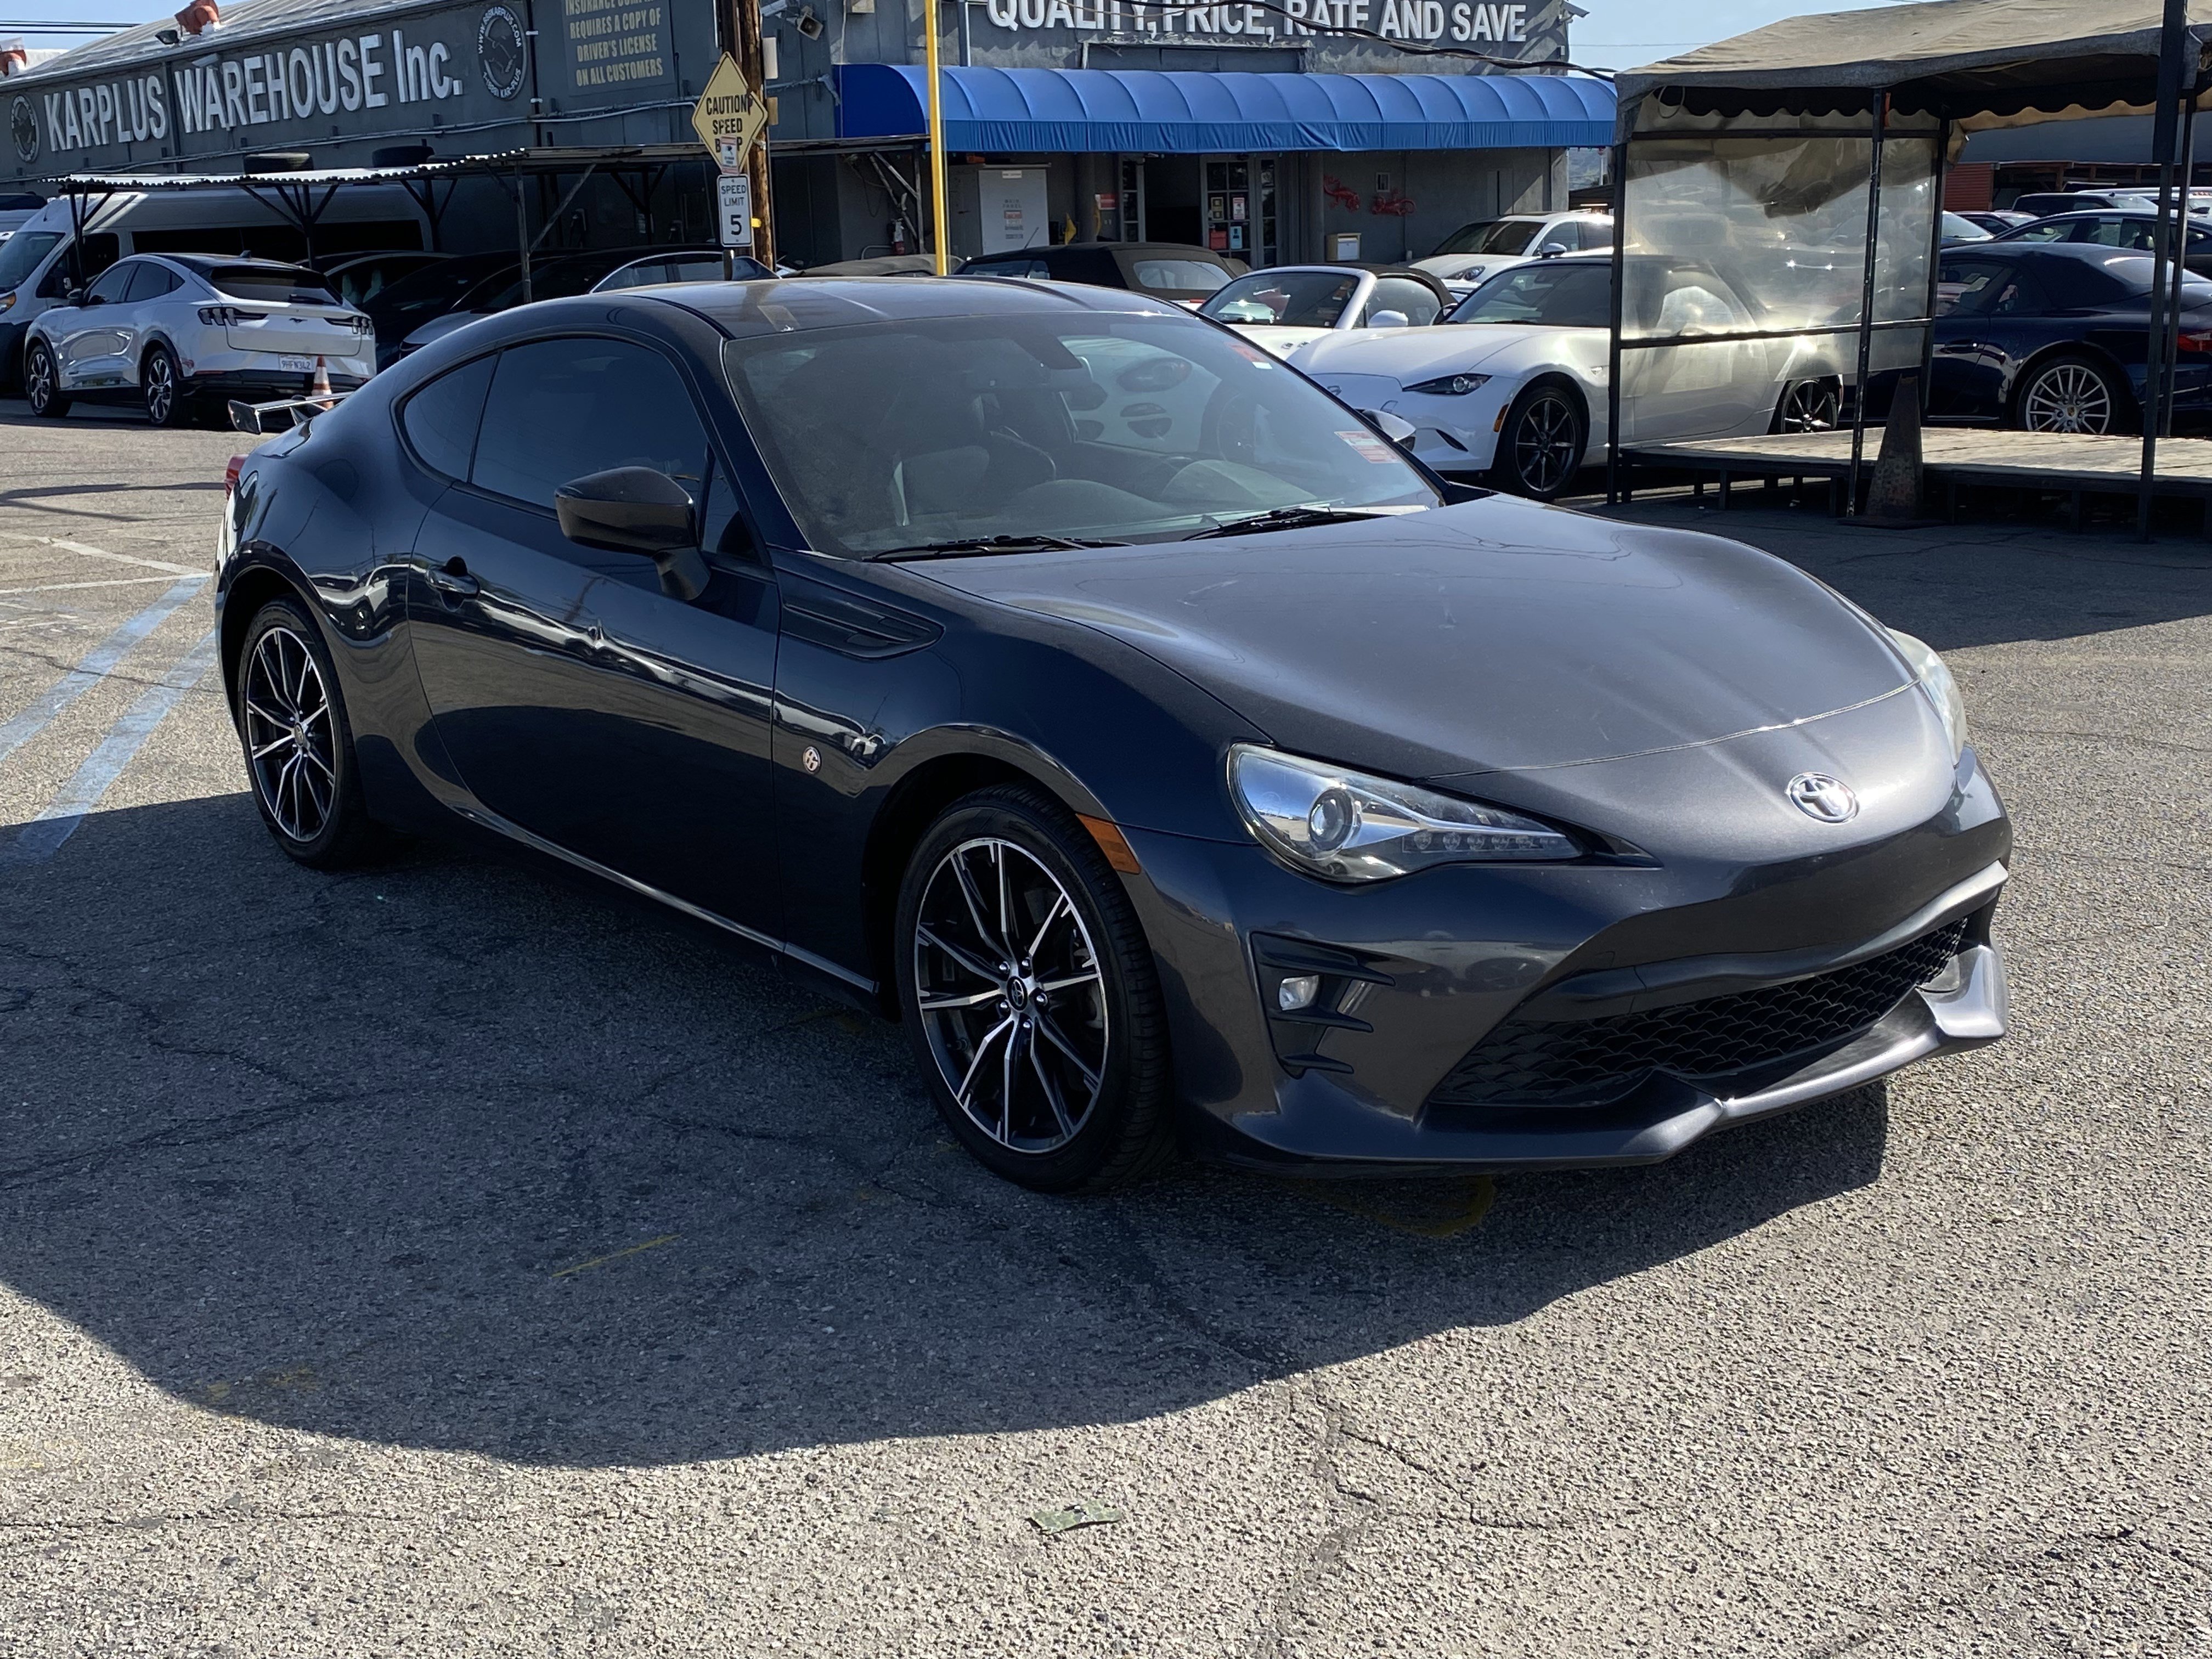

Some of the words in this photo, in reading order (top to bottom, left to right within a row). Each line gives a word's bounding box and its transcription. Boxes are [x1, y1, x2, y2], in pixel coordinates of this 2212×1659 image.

[569, 15, 612, 40] REQUIRES
[614, 15, 620, 32] A
[623, 10, 647, 31] COPY
[649, 8, 661, 26] OF
[988, 0, 1156, 39] QUALITY,
[1163, 0, 1275, 43] PRICE,
[1283, 0, 1369, 36] RATE
[1379, 0, 1444, 40] AND
[1450, 3, 1527, 42] SAVE
[577, 40, 618, 62] DRIVER'S
[619, 33, 657, 56] LICENSE
[577, 69, 589, 87] ON
[590, 66, 606, 84] ALL
[606, 58, 663, 82] CUSTOMERS
[44, 75, 168, 151] KARPLUS
[174, 33, 389, 133] WAREHOUSE
[392, 30, 464, 103] Inc.
[706, 94, 747, 115] CAUTION
[713, 118, 742, 134] SPEED
[715, 137, 742, 153] BP
[721, 185, 747, 194] SPEED
[724, 197, 744, 206] LIMIT
[731, 215, 742, 235] 5
